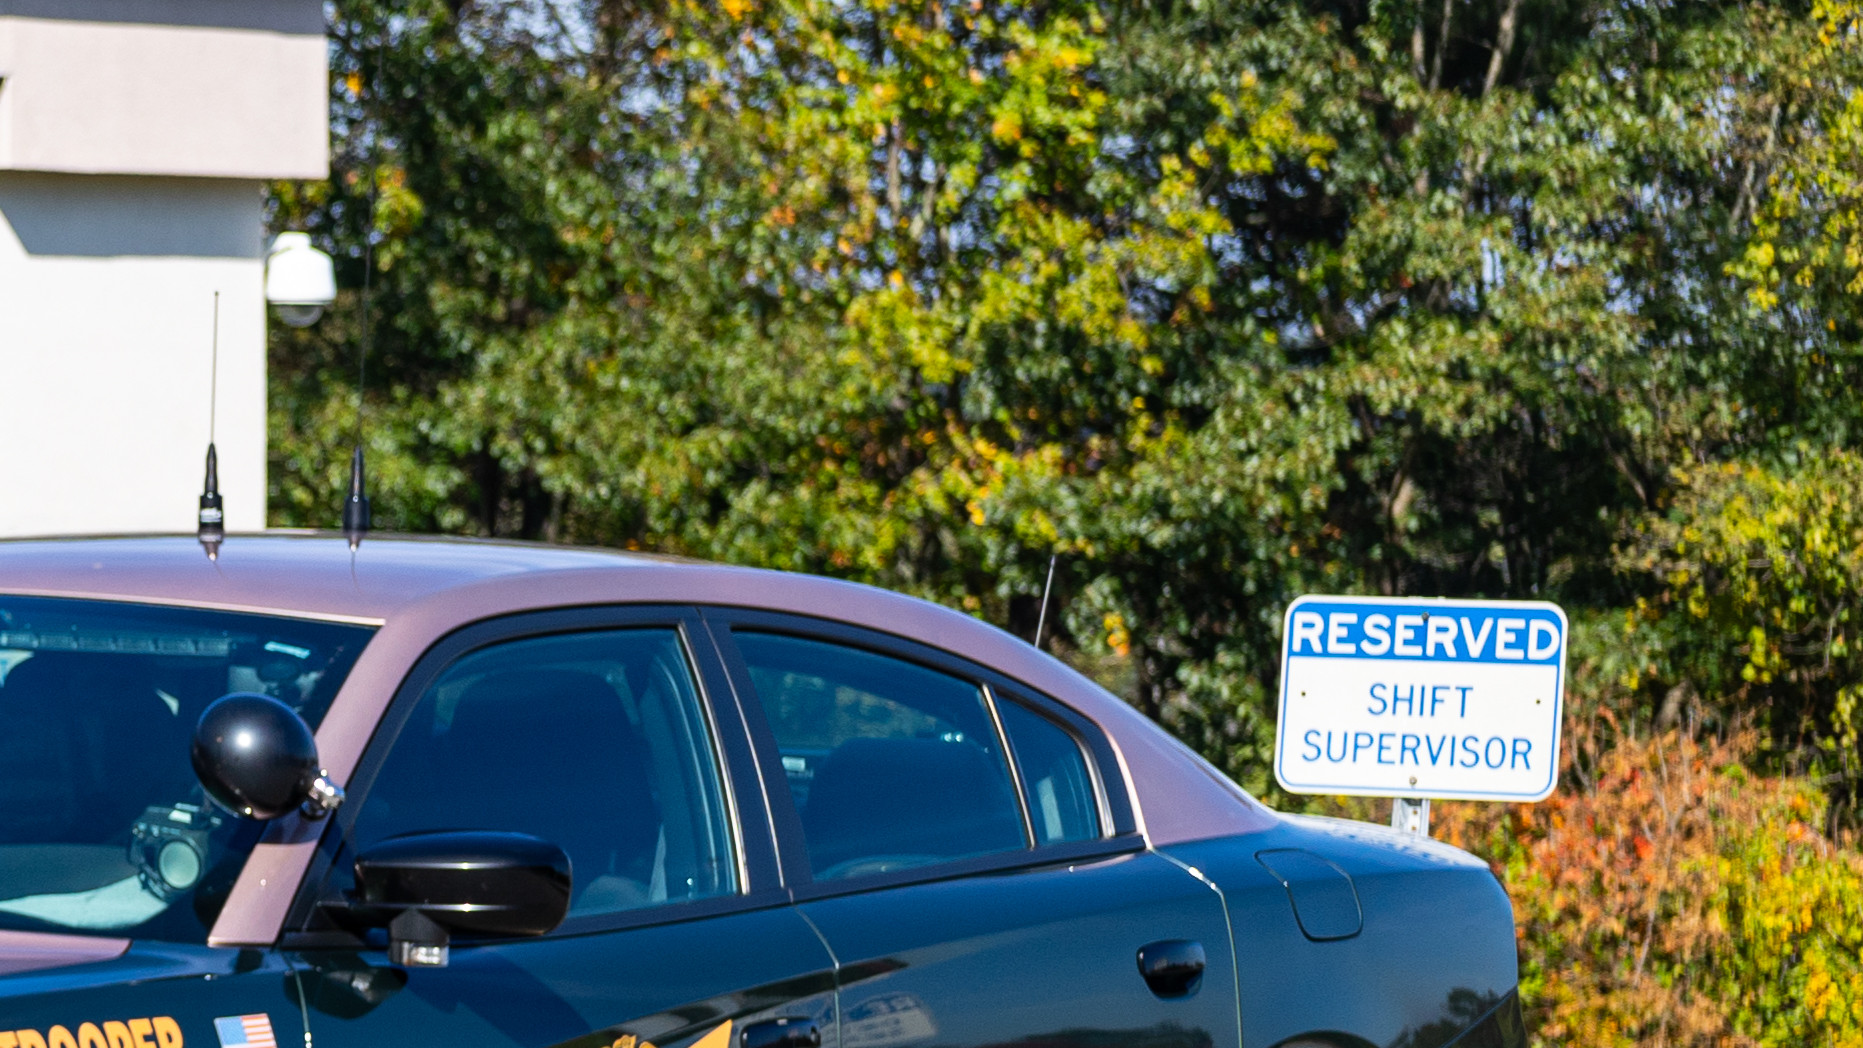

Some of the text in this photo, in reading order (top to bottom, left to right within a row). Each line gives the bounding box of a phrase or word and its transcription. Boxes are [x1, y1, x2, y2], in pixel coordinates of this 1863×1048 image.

[1291, 611, 1561, 661] RESERVED
[1367, 683, 1474, 719] SHIFT
[1301, 729, 1533, 770] SUPERVISOR
